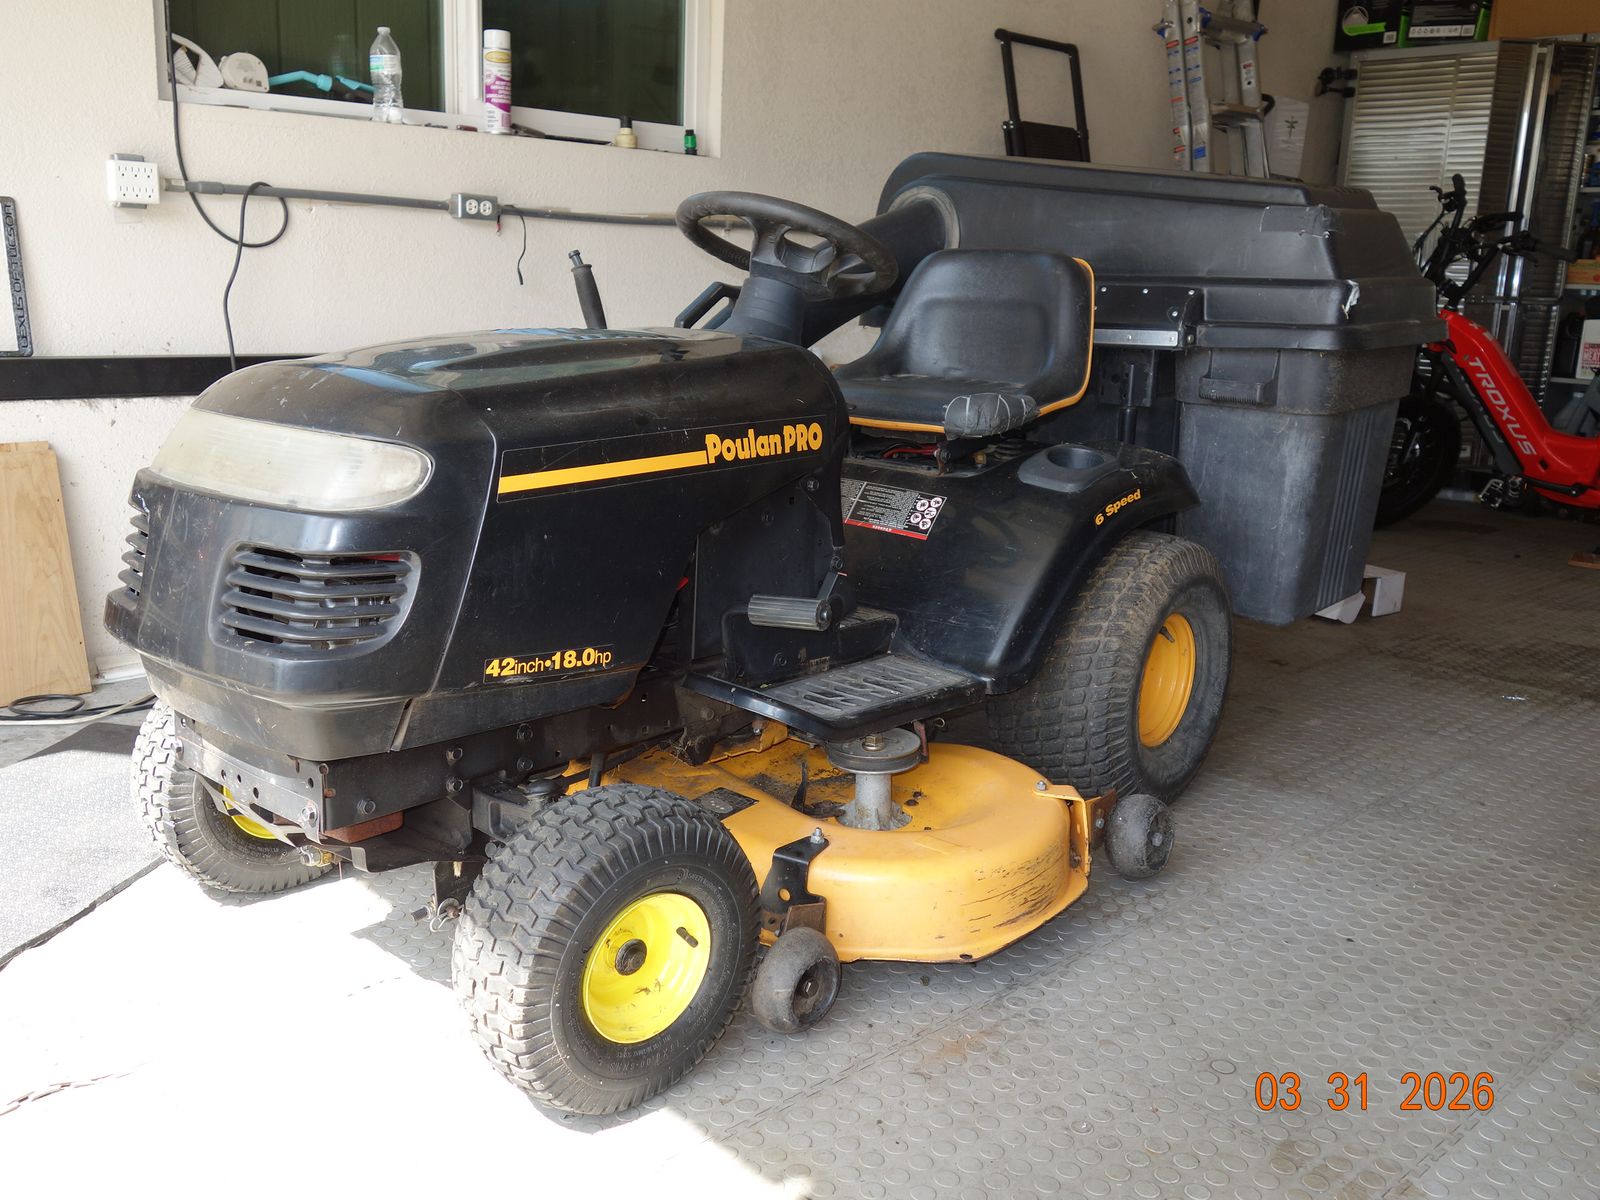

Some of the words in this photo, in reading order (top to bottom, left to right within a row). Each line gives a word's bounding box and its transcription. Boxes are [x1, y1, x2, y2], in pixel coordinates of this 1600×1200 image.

[10, 269, 22, 293] OF
[17, 296, 29, 349] LEXUS
[1468, 356, 1537, 456] TROXUS
[1095, 513, 1105, 526] 6
[1105, 489, 1141, 517] Speed
